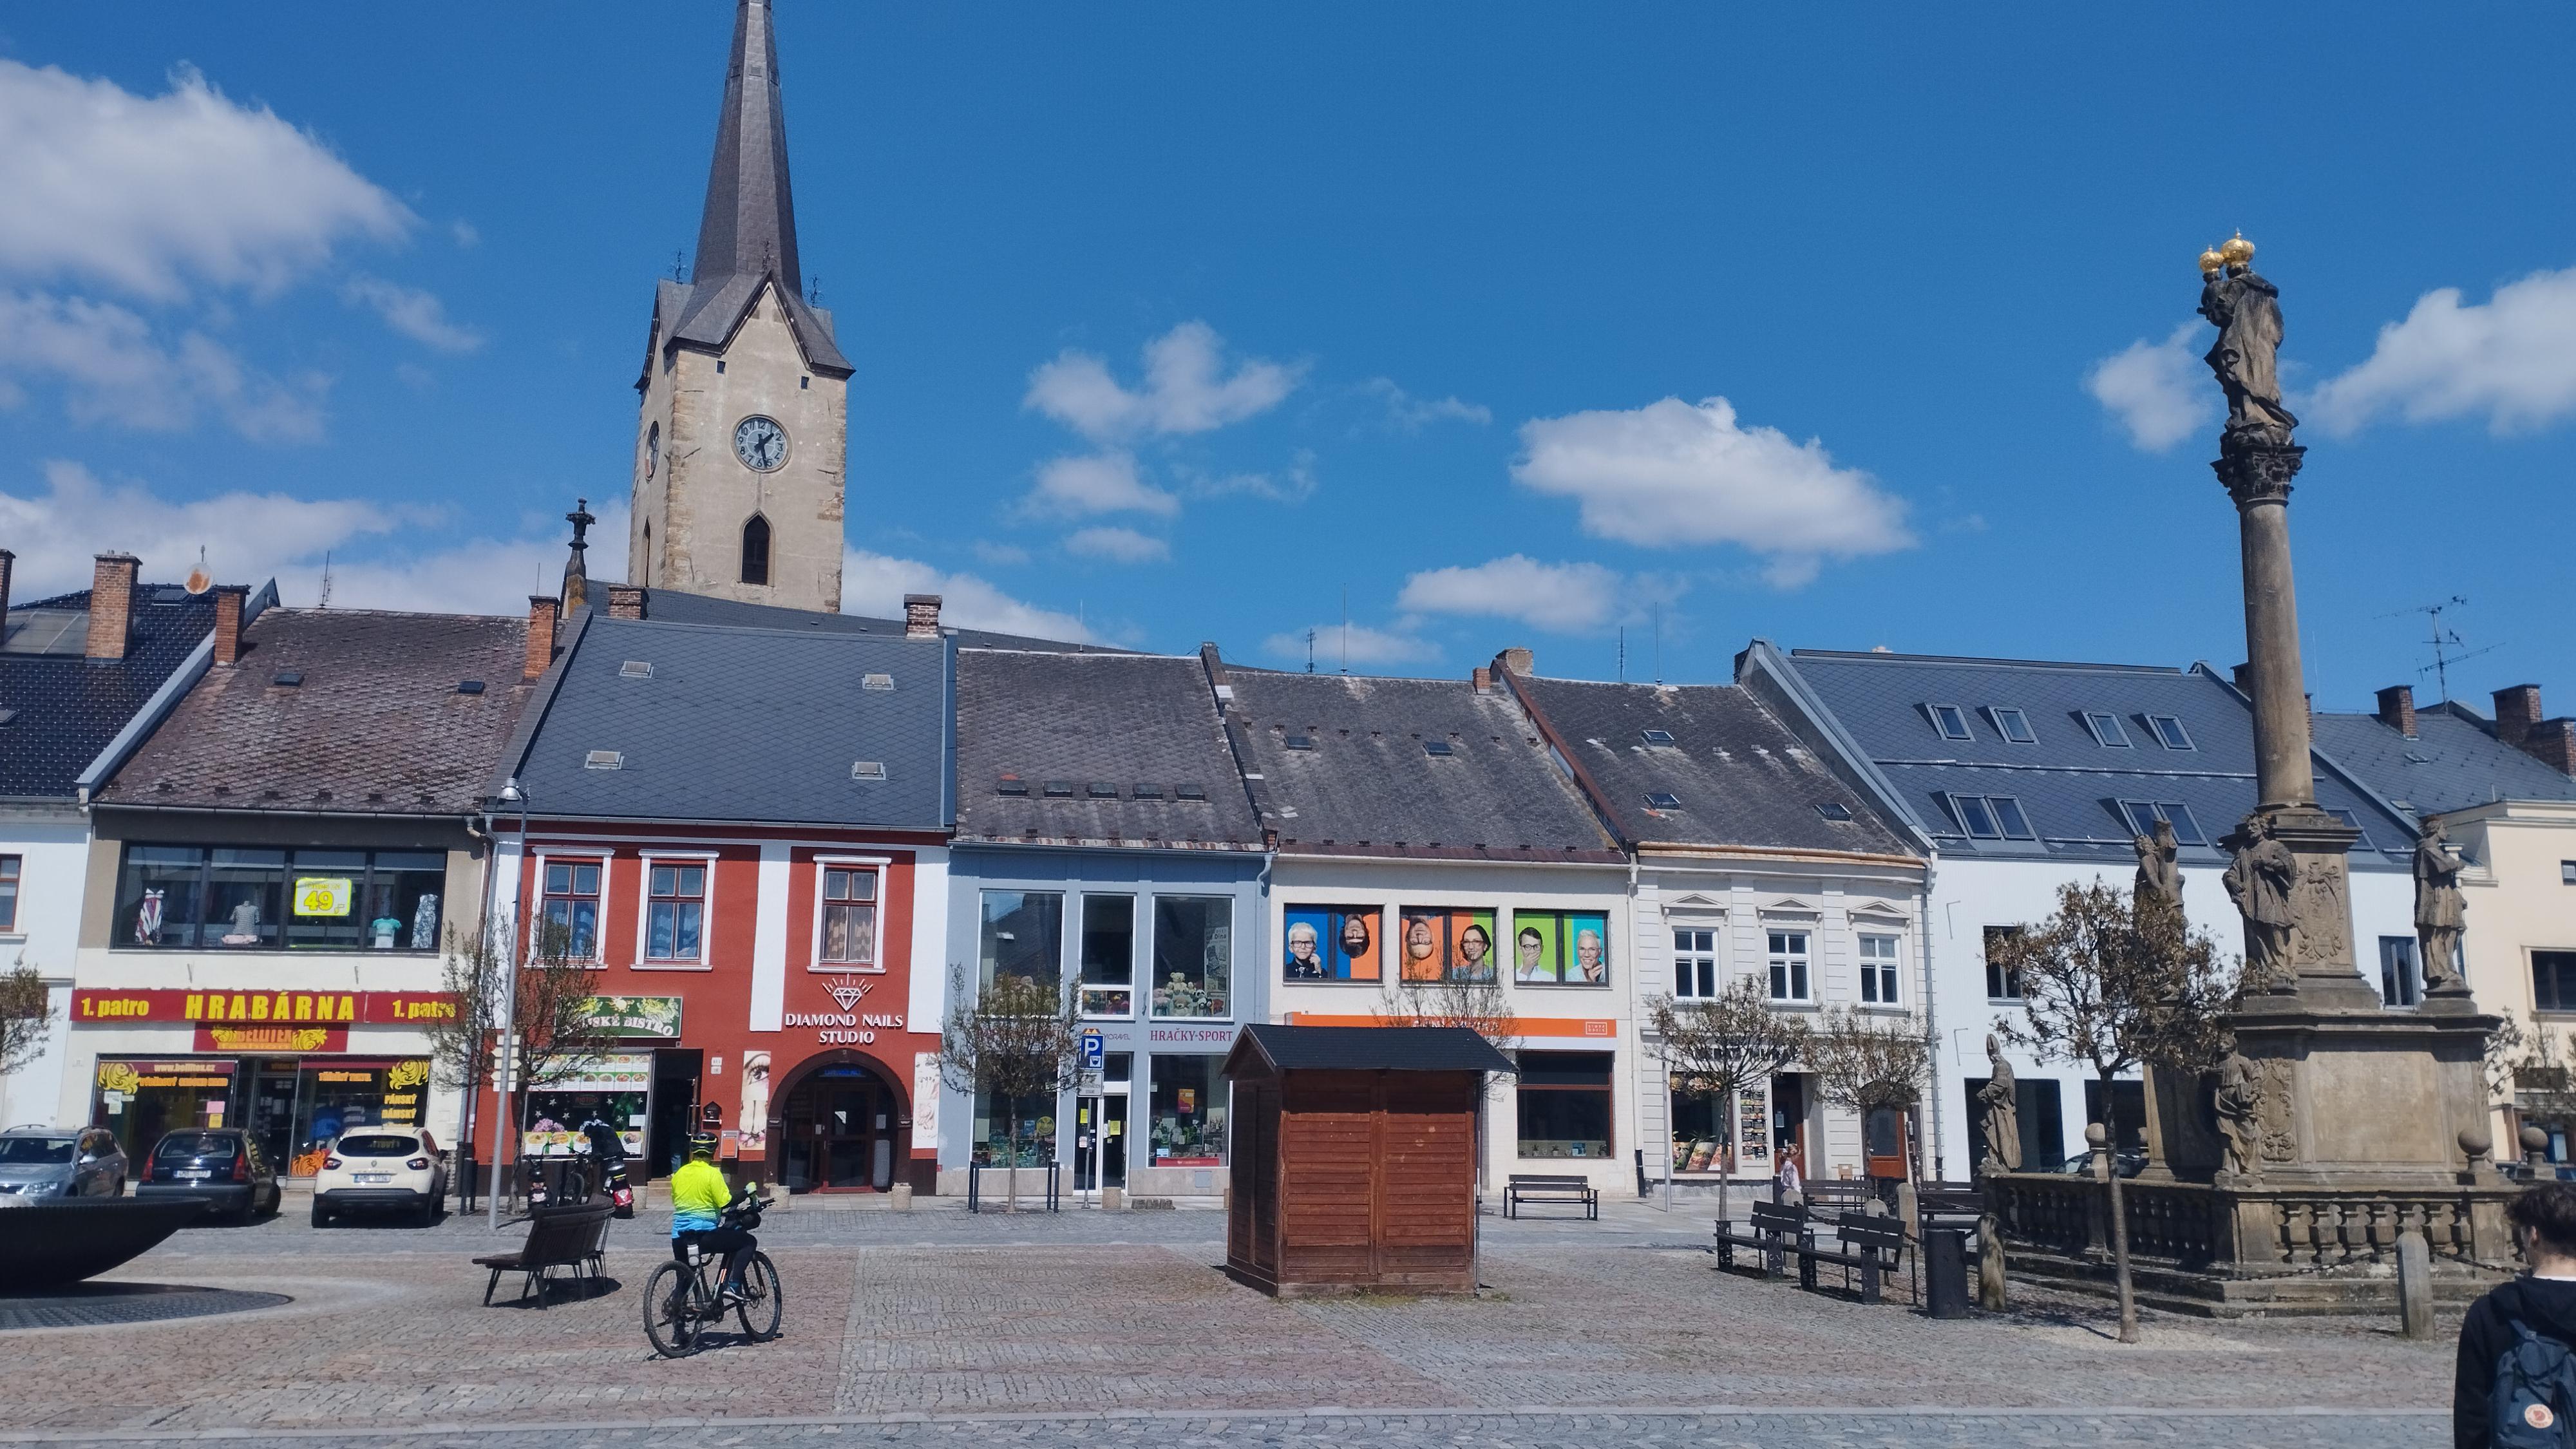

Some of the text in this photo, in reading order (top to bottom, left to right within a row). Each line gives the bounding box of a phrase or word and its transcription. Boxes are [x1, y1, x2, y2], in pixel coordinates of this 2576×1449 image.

[758, 420, 766, 430] 12
[741, 426, 748, 435] 10
[738, 437, 743, 446] 9
[776, 433, 782, 441] 2
[740, 446, 745, 455] 8
[777, 443, 783, 452] 3
[747, 455, 753, 464] 7
[757, 458, 762, 467] 6
[766, 459, 772, 467] 5
[81, 998, 149, 1018] 1. patro
[185, 992, 354, 1019] HRABÁRNA
[392, 999, 405, 1018] 1.
[785, 1014, 903, 1027] DIAMOND NAILS
[623, 1016, 674, 1036] BISTRO
[819, 1031, 875, 1043] STUDIO
[1150, 1027, 1233, 1041] HRAČKY-SPORT
[1084, 1038, 1099, 1057] P
